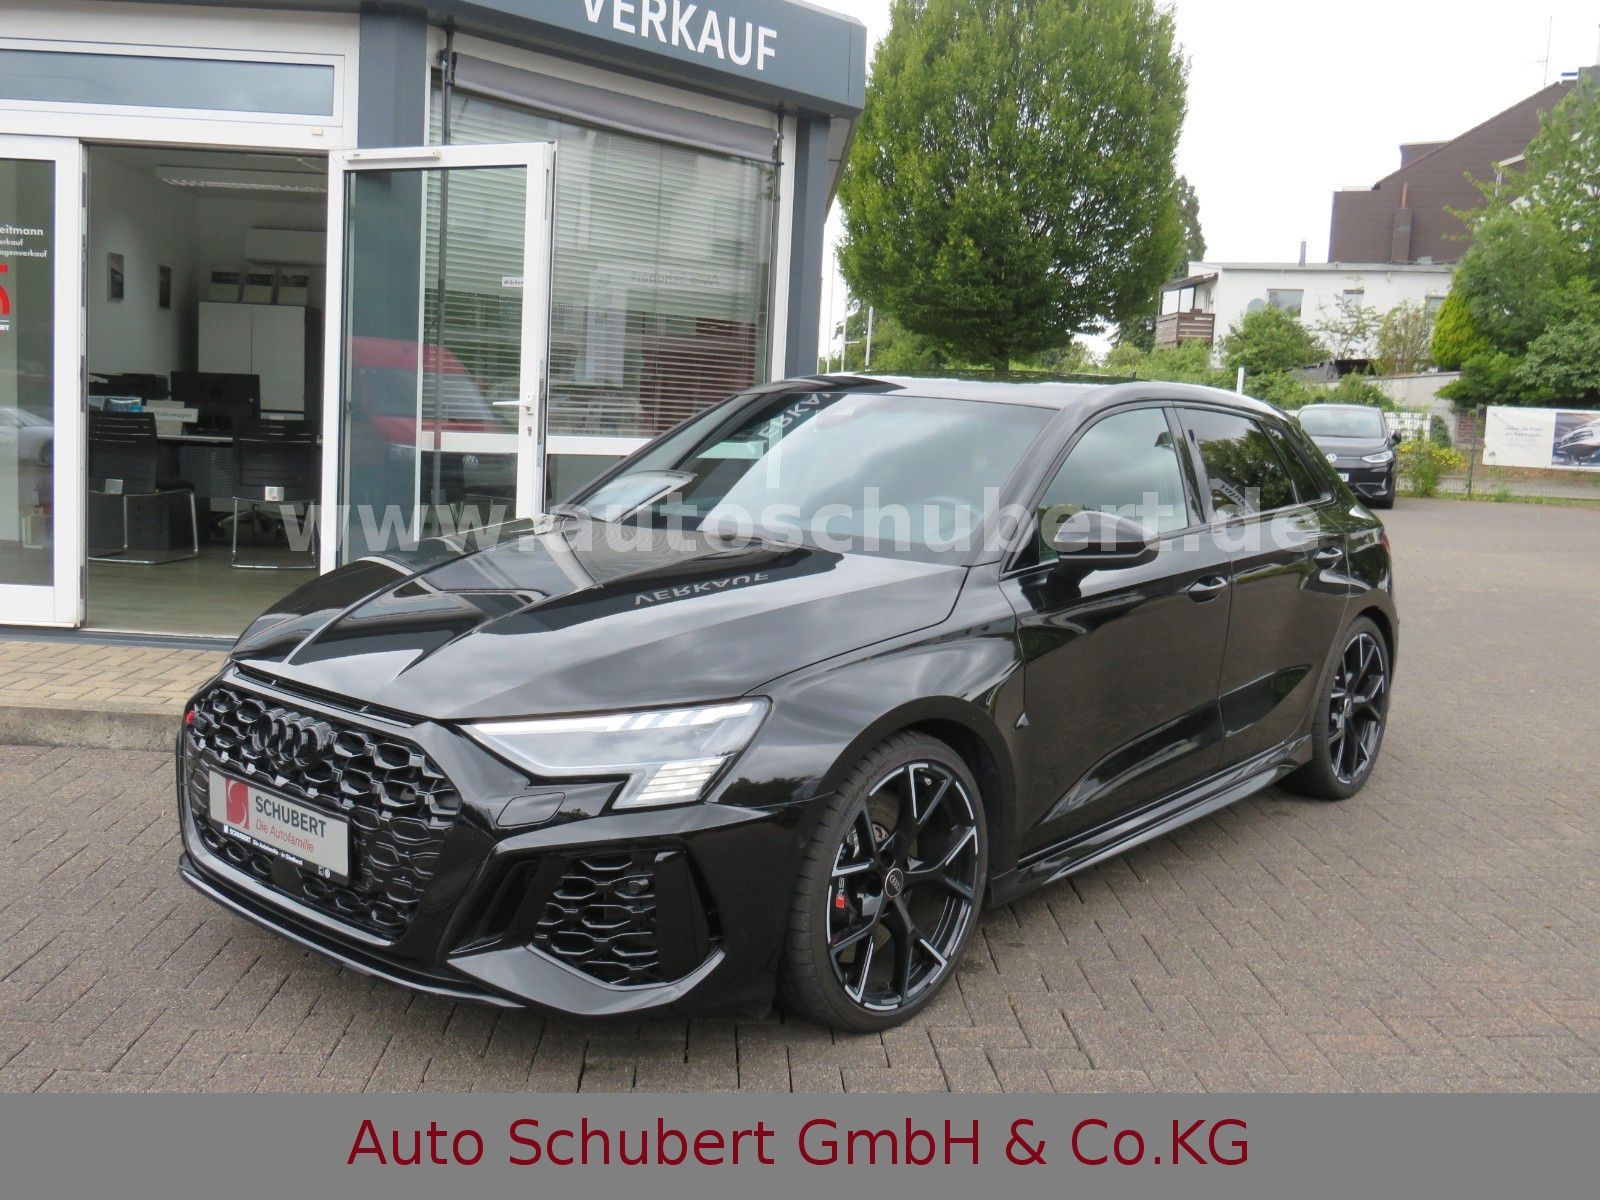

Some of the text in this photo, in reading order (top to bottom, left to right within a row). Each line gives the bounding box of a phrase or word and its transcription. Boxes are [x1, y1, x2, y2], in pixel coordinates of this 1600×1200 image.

[584, 0, 778, 71] VERKAUF
[155, 410, 193, 419] Volkswagen
[255, 795, 327, 838] SCHUBERT
[255, 818, 314, 852] Die Autofamilie
